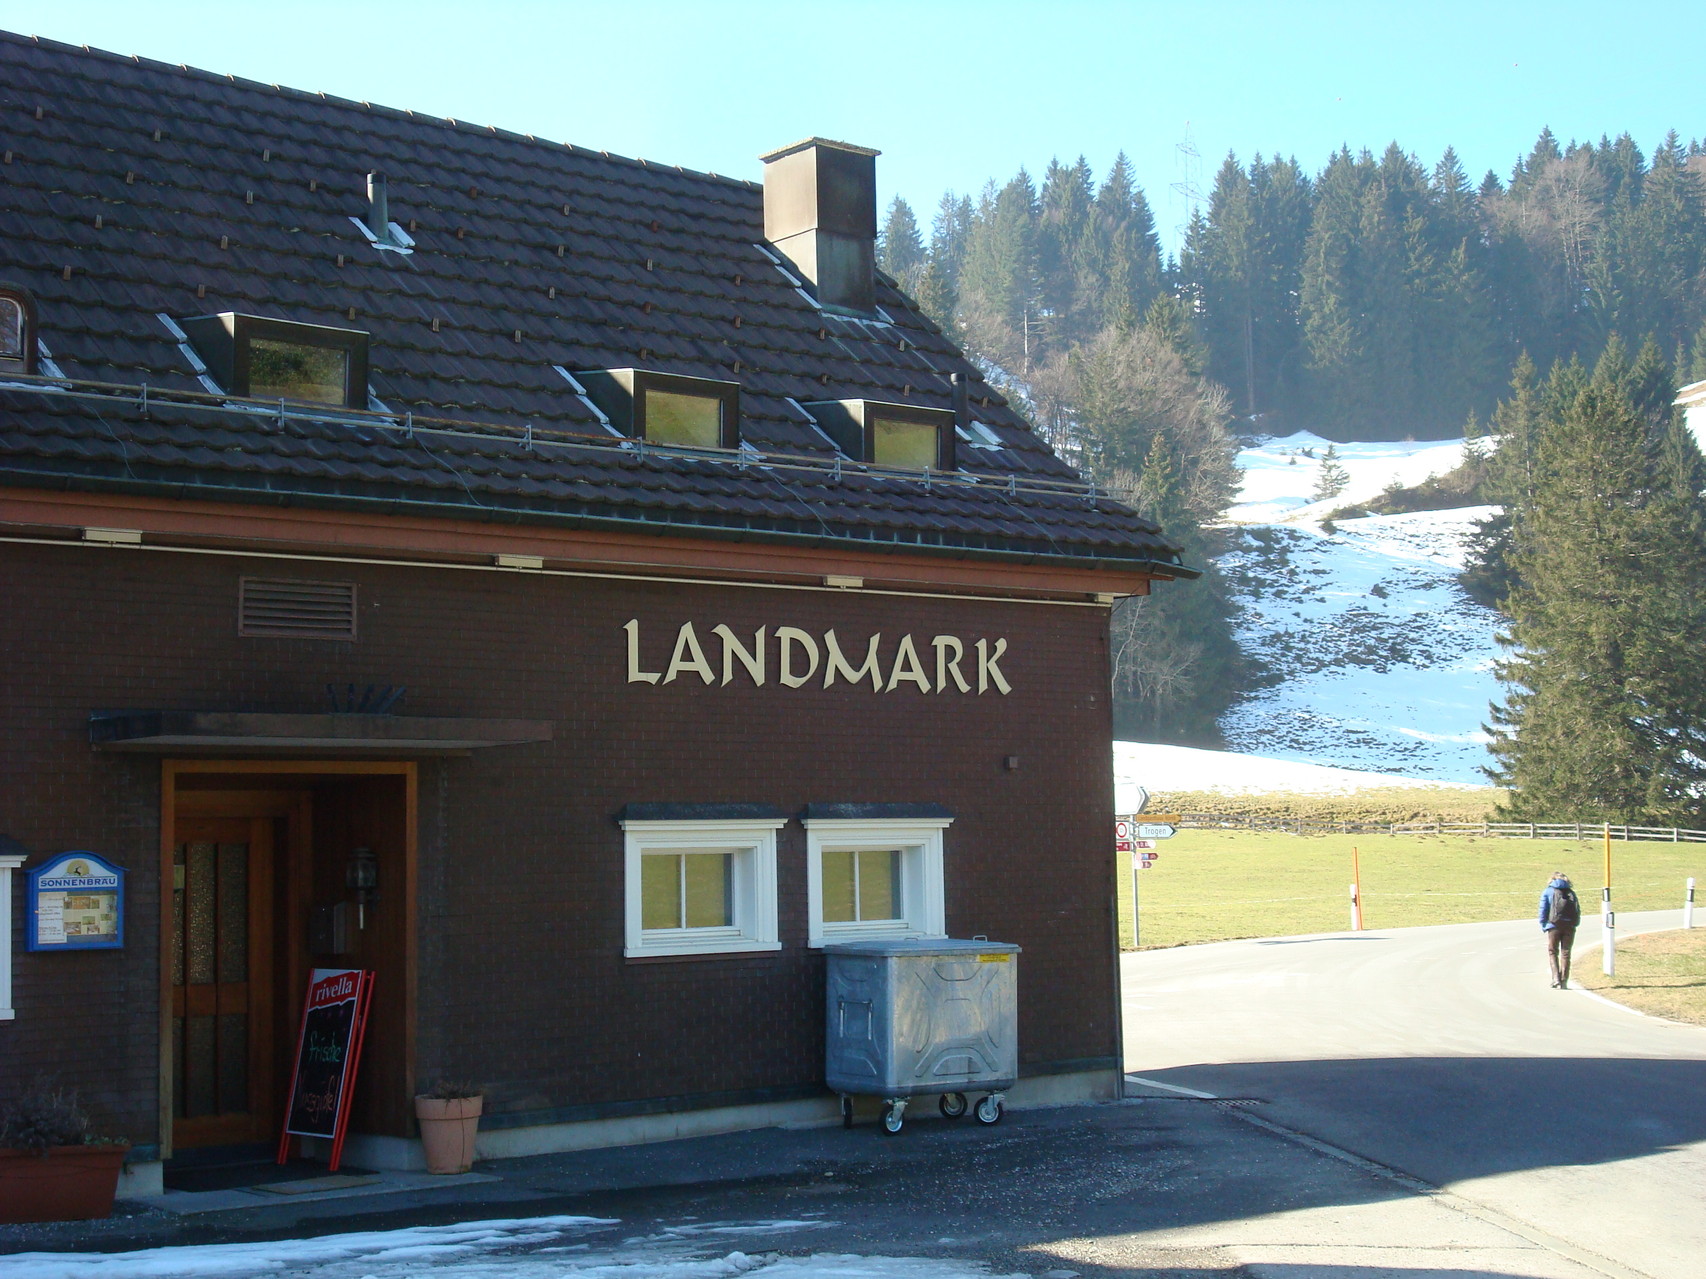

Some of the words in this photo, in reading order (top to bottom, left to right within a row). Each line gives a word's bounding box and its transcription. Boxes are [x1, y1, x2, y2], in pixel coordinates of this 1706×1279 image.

[622, 618, 1013, 695] LANDMARK
[1144, 826, 1167, 837] Trogen
[40, 877, 116, 887] SONNENBRÄU
[315, 977, 353, 1002] rivella
